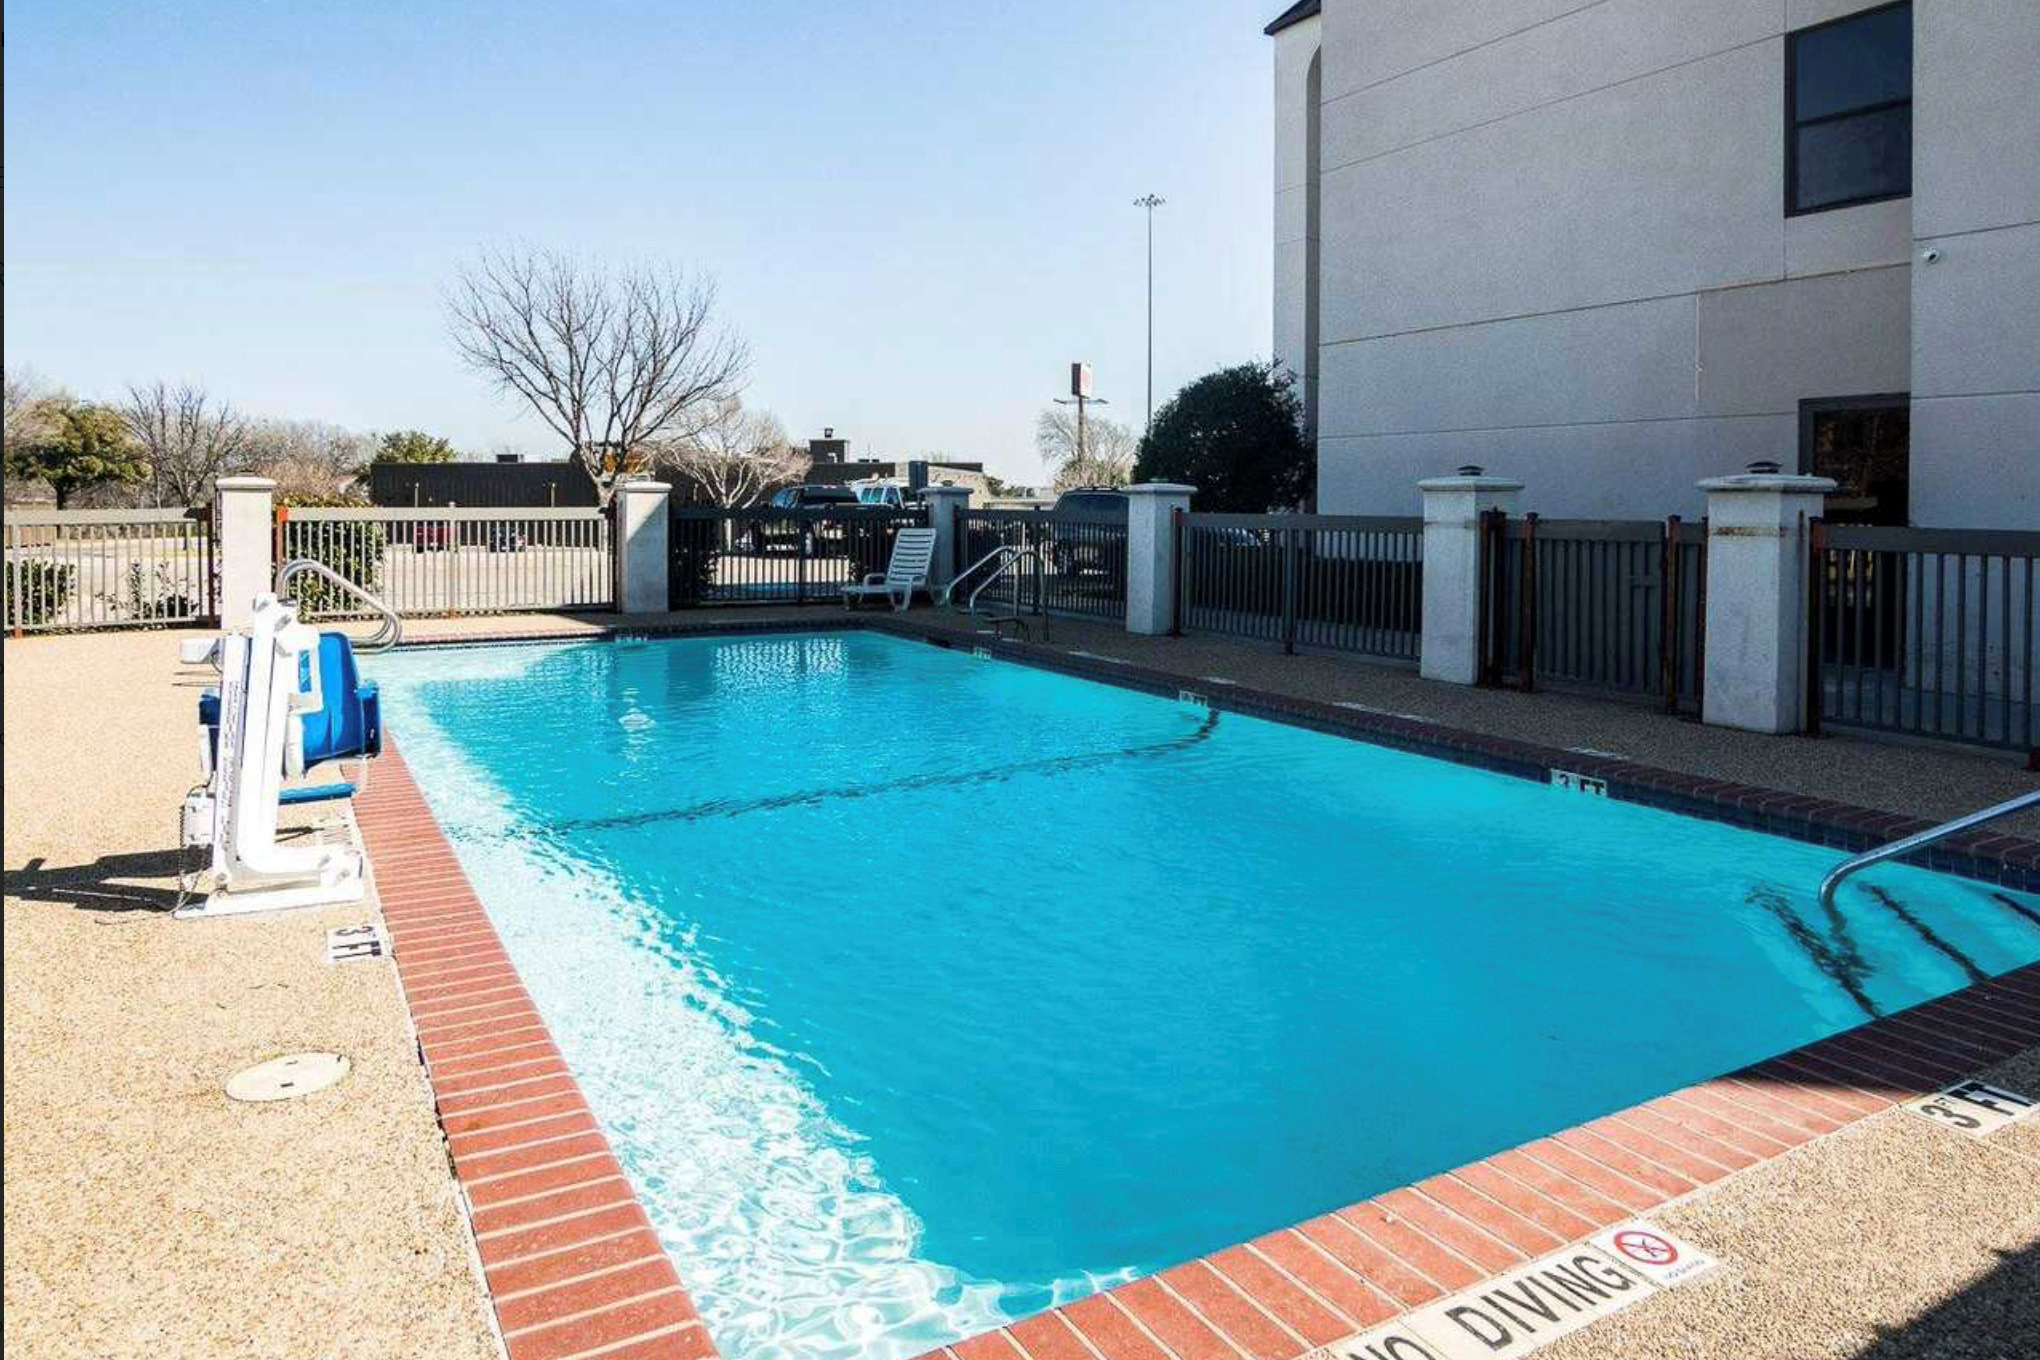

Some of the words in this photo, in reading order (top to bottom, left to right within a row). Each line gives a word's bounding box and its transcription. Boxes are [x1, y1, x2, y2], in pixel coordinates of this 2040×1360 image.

[332, 940, 382, 959] FT
[1946, 1082, 2034, 1116] FT
[1921, 1104, 1981, 1128] 3
[1444, 1256, 1636, 1351] DIVING
